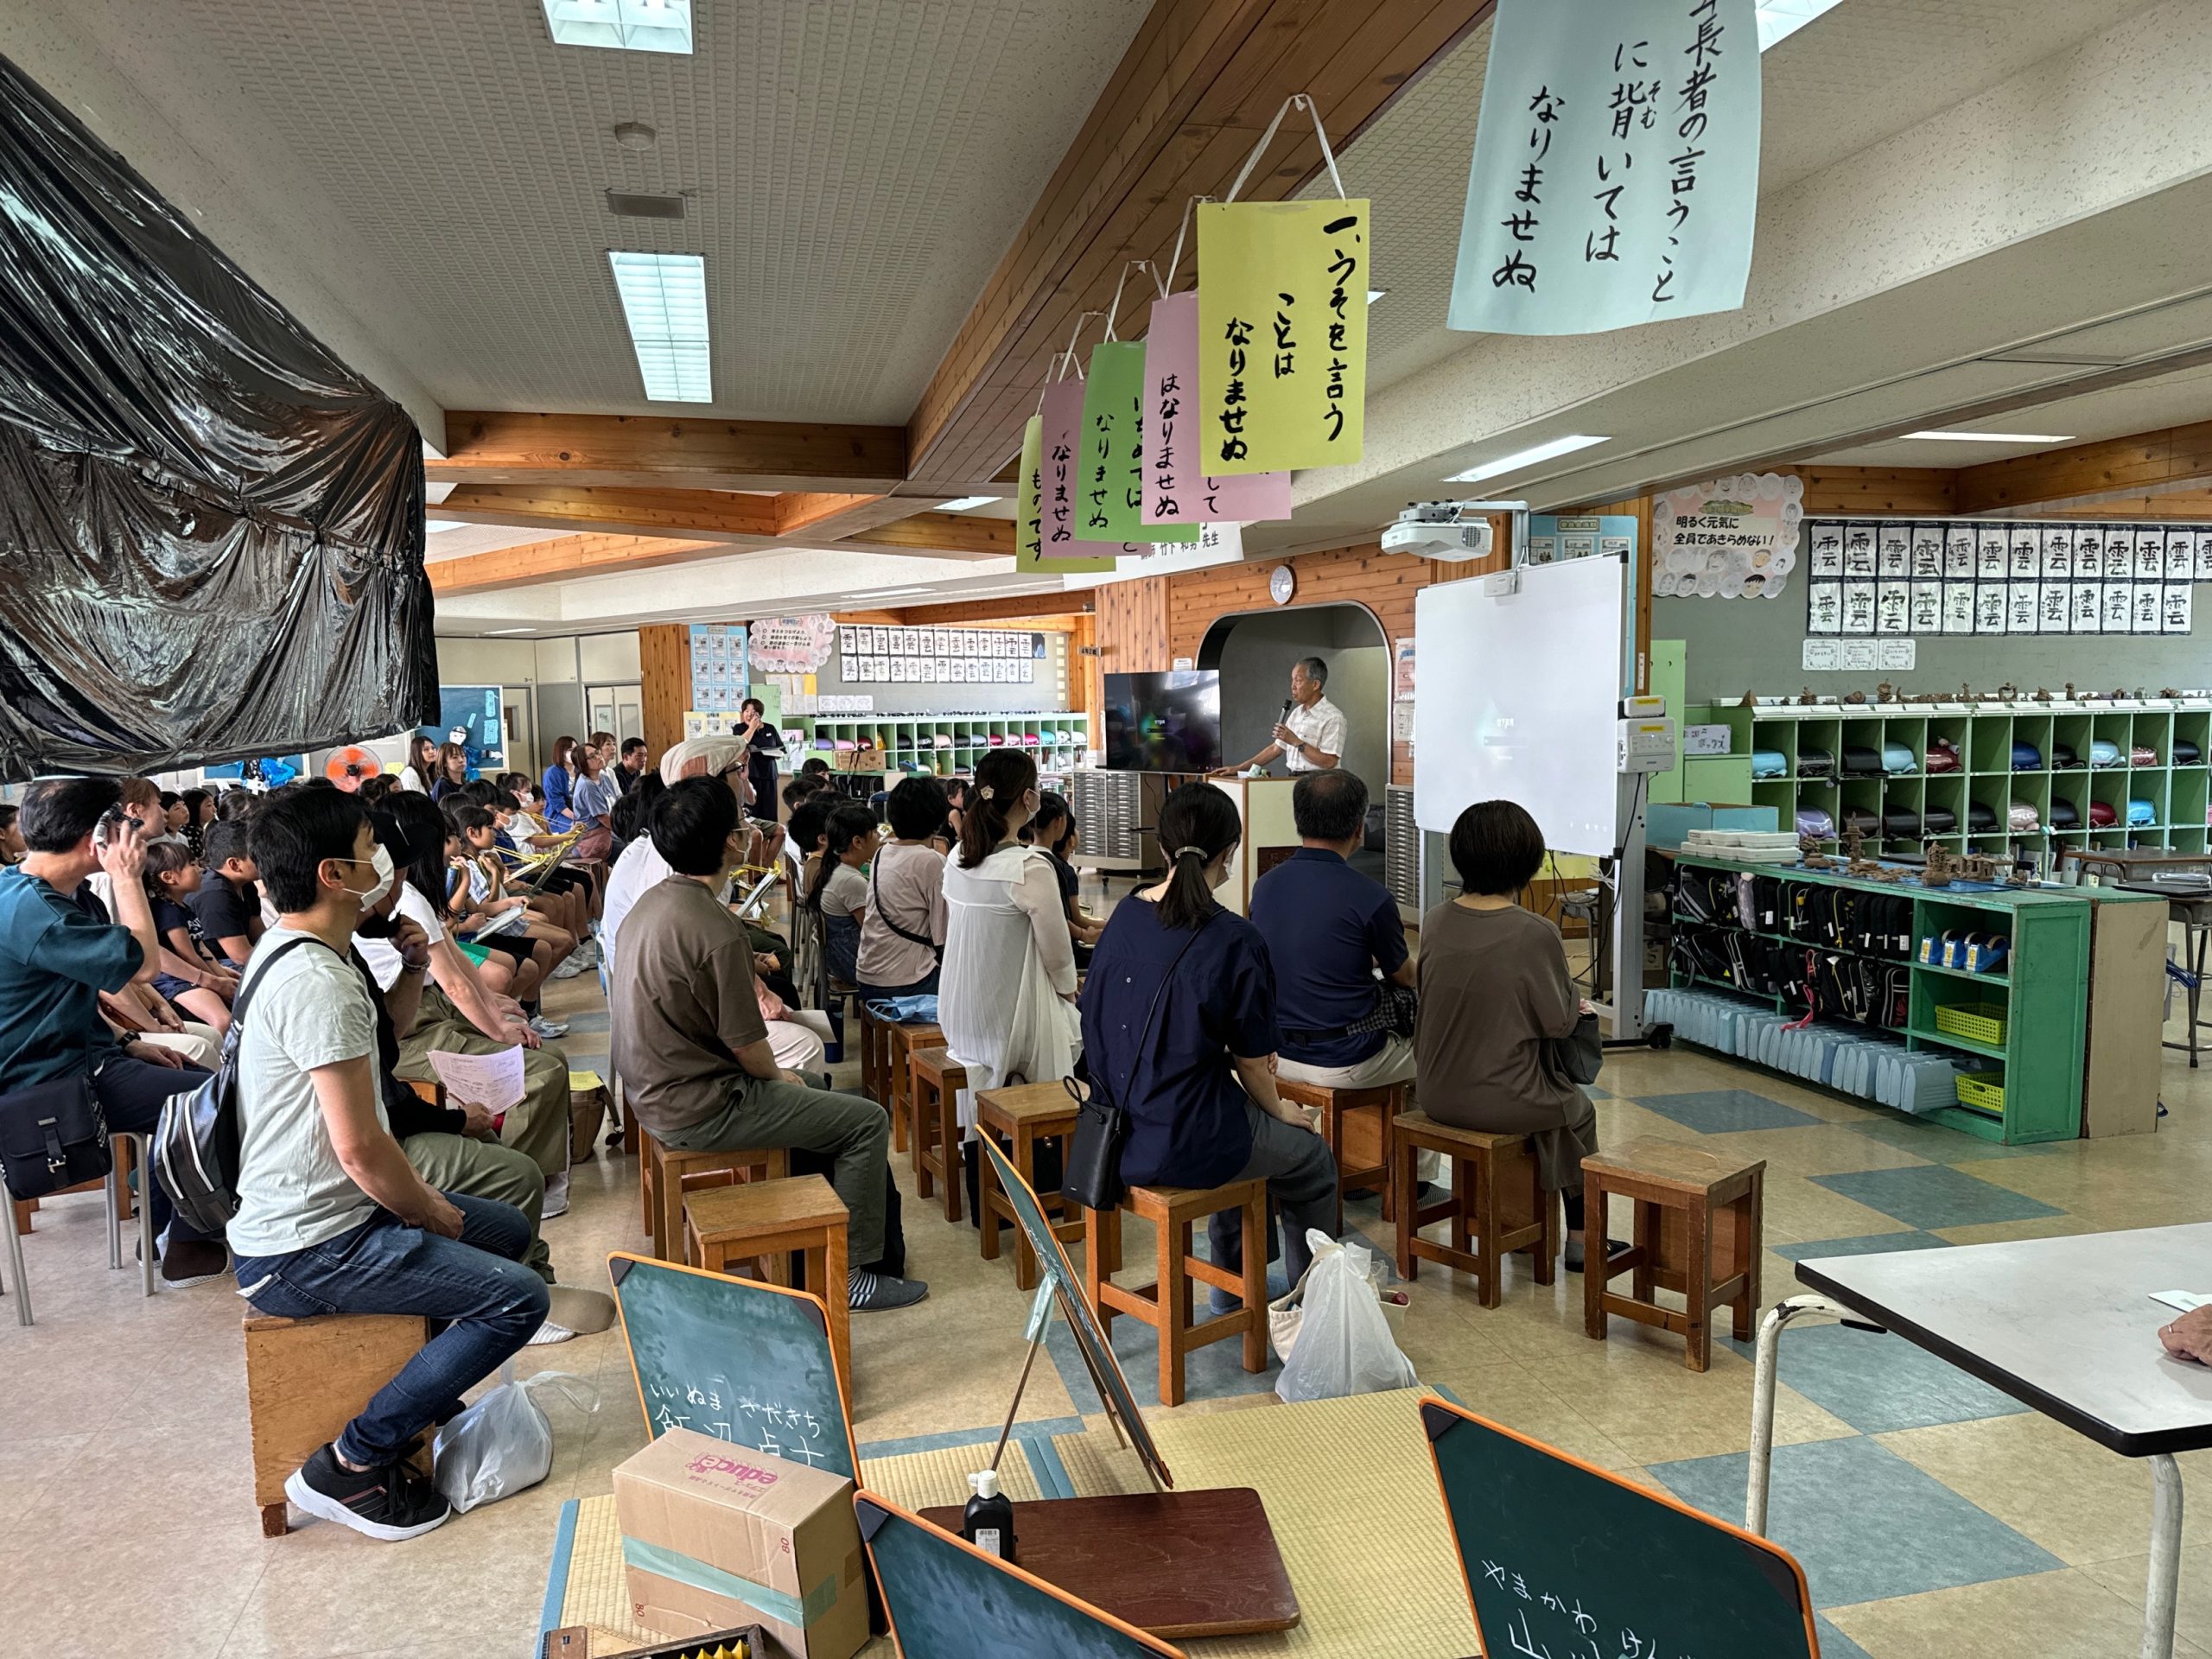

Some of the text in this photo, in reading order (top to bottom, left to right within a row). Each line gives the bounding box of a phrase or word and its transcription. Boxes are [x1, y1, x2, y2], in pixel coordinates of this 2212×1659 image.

[1640, 79, 1662, 130] そむ
[1585, 41, 1648, 262] に背いては
[1491, 85, 1566, 294] なりませぬ
[1273, 293, 1297, 379] ことは
[1323, 216, 1362, 442] 一、うそを言う
[1219, 316, 1255, 461] なりませぬ
[1154, 374, 1181, 518] はなりませぬ
[1088, 414, 1115, 528] なりませぬ
[1051, 443, 1071, 543] なりませぬ
[1676, 516, 1738, 529] 明るく元気に
[1202, 530, 1219, 549] 先生
[1816, 536, 1839, 567] 雲
[1851, 532, 1872, 572] 雲
[1885, 539, 1907, 569] 雲
[1952, 537, 1972, 567] 雲
[1982, 541, 2002, 570] 雲
[2014, 541, 2034, 570] 雲
[2050, 536, 2069, 572] 雲
[2079, 537, 2100, 573] 雲
[2171, 541, 2189, 569] 雲
[1916, 538, 1940, 575] 雲
[2107, 540, 2130, 575] 雲
[2139, 540, 2161, 572] 雲
[1818, 595, 1836, 623] 雲
[1850, 592, 1872, 627] 雲
[1880, 589, 1905, 630] 雲
[1914, 592, 1937, 626] 雲
[1953, 592, 1971, 620] 雲
[1981, 593, 2002, 626] 雲
[2013, 594, 2032, 623] 雲
[2045, 590, 2064, 621] 雲
[2079, 589, 2094, 618] 雲
[2108, 590, 2127, 620] 雲
[2139, 593, 2156, 621] 雲
[2165, 594, 2187, 625] 雲
[780, 1537, 791, 1554] 80
[634, 1603, 645, 1618] 80
[1481, 1559, 1598, 1635] やまかわ
